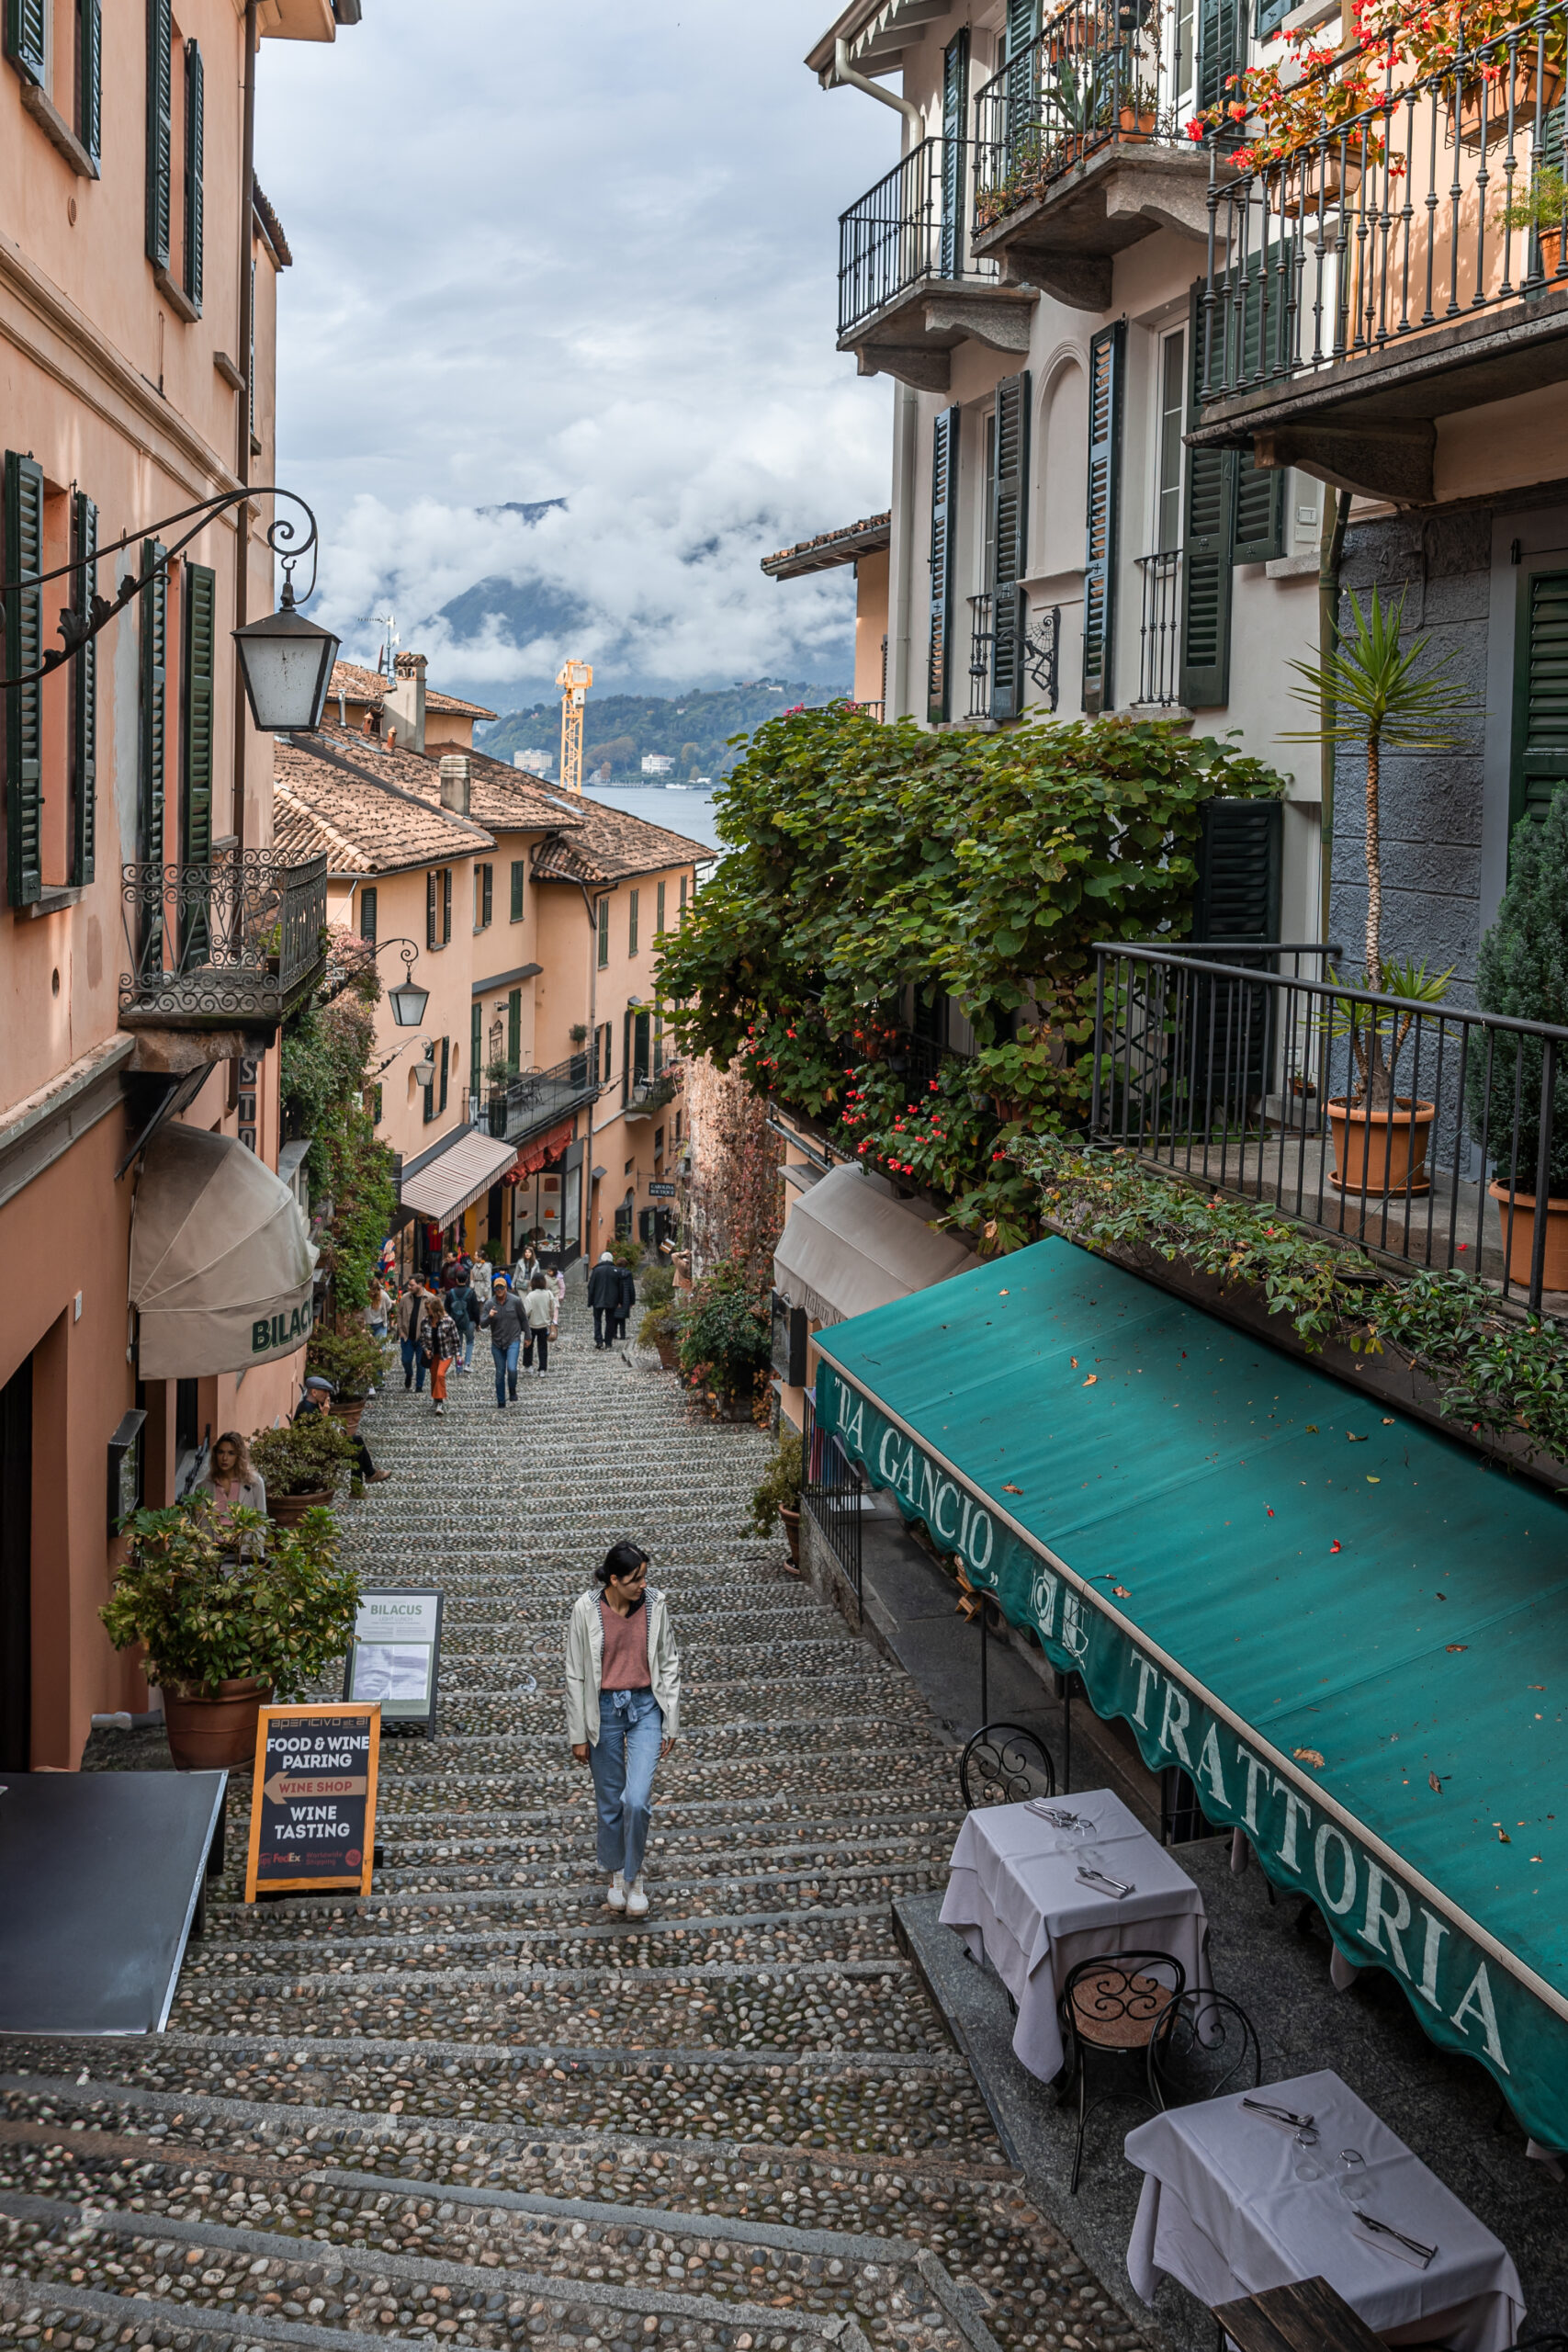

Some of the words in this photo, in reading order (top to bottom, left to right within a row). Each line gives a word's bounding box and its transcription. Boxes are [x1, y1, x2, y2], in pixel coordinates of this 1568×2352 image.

[370, 1604, 423, 1615] BILACUS
[266, 1737, 311, 1752] FOOD
[314, 1736, 325, 1750] &
[327, 1736, 369, 1750] WINE
[282, 1753, 352, 1769] PAIRING
[279, 1782, 313, 1793] WINE
[316, 1781, 353, 1792] SHOP
[290, 1805, 337, 1821] WINE
[275, 1823, 350, 1839] TASTING
[273, 1852, 300, 1863] FedEx
[1129, 1648, 1510, 2075] TRATTORIA
